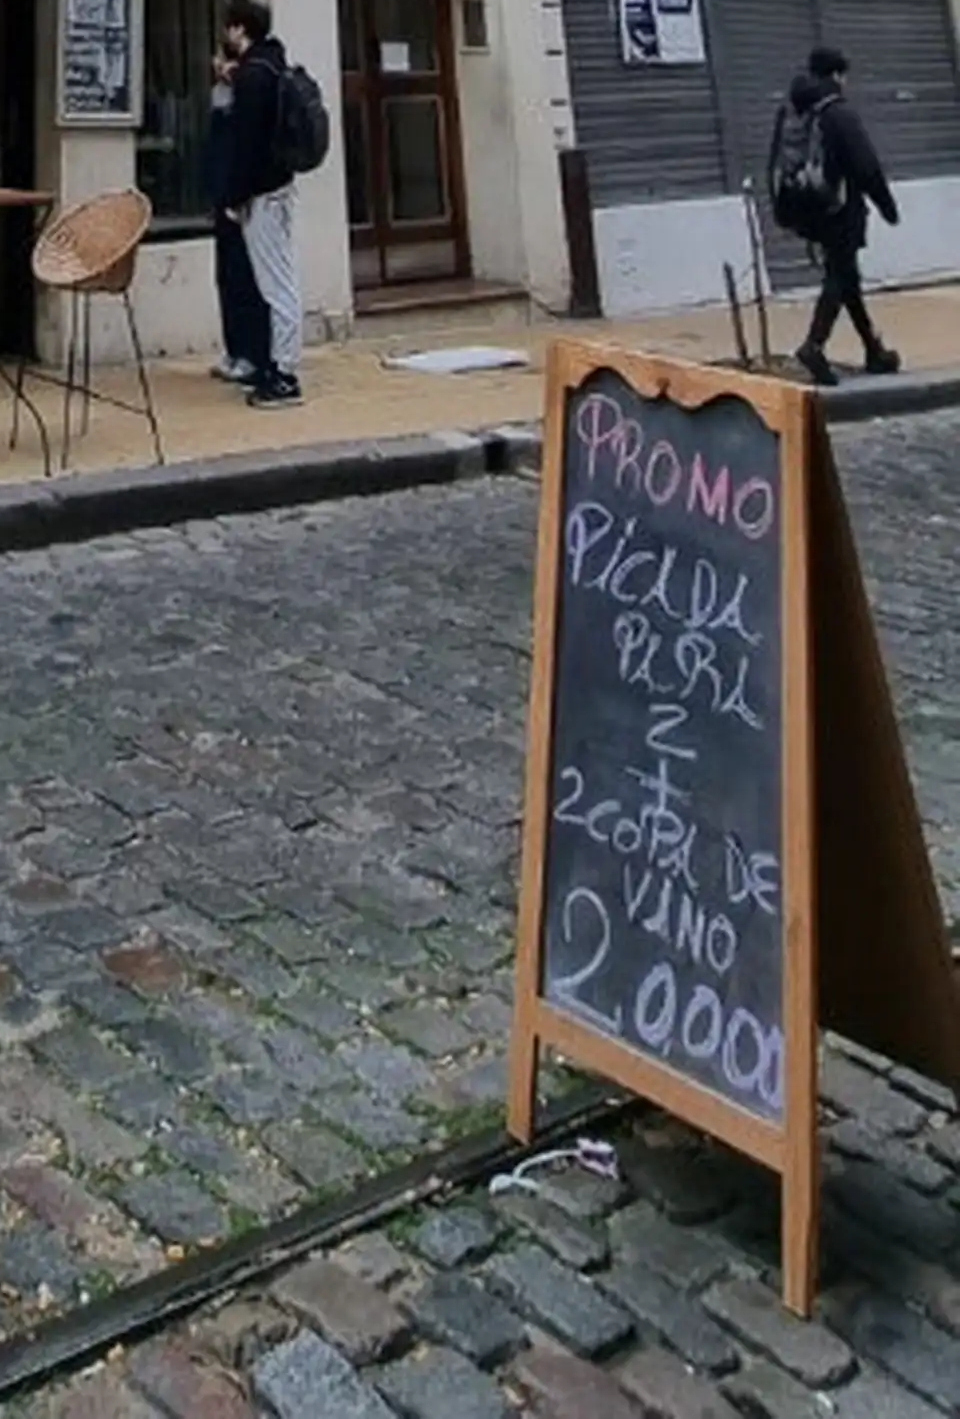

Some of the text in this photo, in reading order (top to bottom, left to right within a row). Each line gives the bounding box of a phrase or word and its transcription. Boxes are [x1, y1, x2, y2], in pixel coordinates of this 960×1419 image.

[577, 394, 773, 540] PROMO
[613, 612, 765, 730] PARA
[623, 863, 736, 976] VINO
[725, 831, 779, 914] DE
